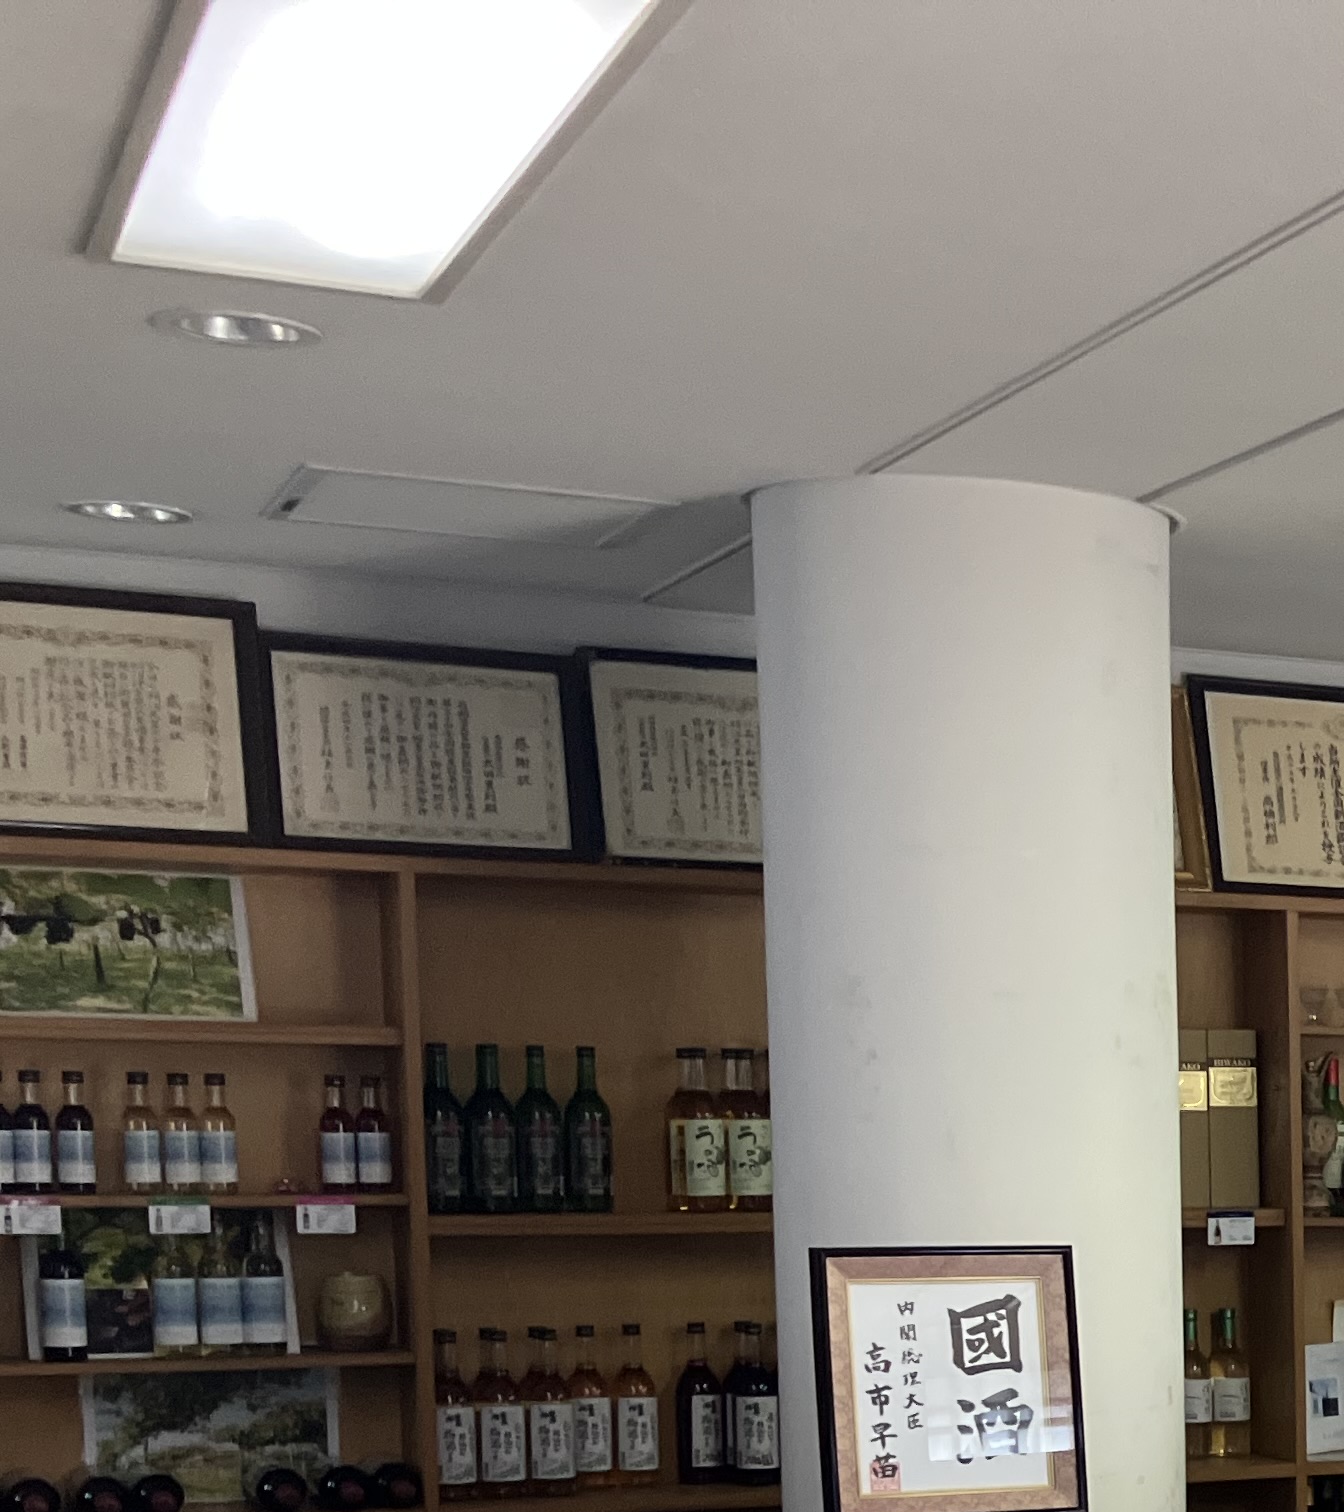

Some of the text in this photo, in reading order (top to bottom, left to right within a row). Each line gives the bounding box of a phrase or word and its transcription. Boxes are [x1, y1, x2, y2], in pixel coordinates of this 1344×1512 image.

[1213, 1059, 1251, 1067] BIWAKO
[864, 1343, 898, 1480] 高市早苗
[947, 1293, 1034, 1465] 國酒
